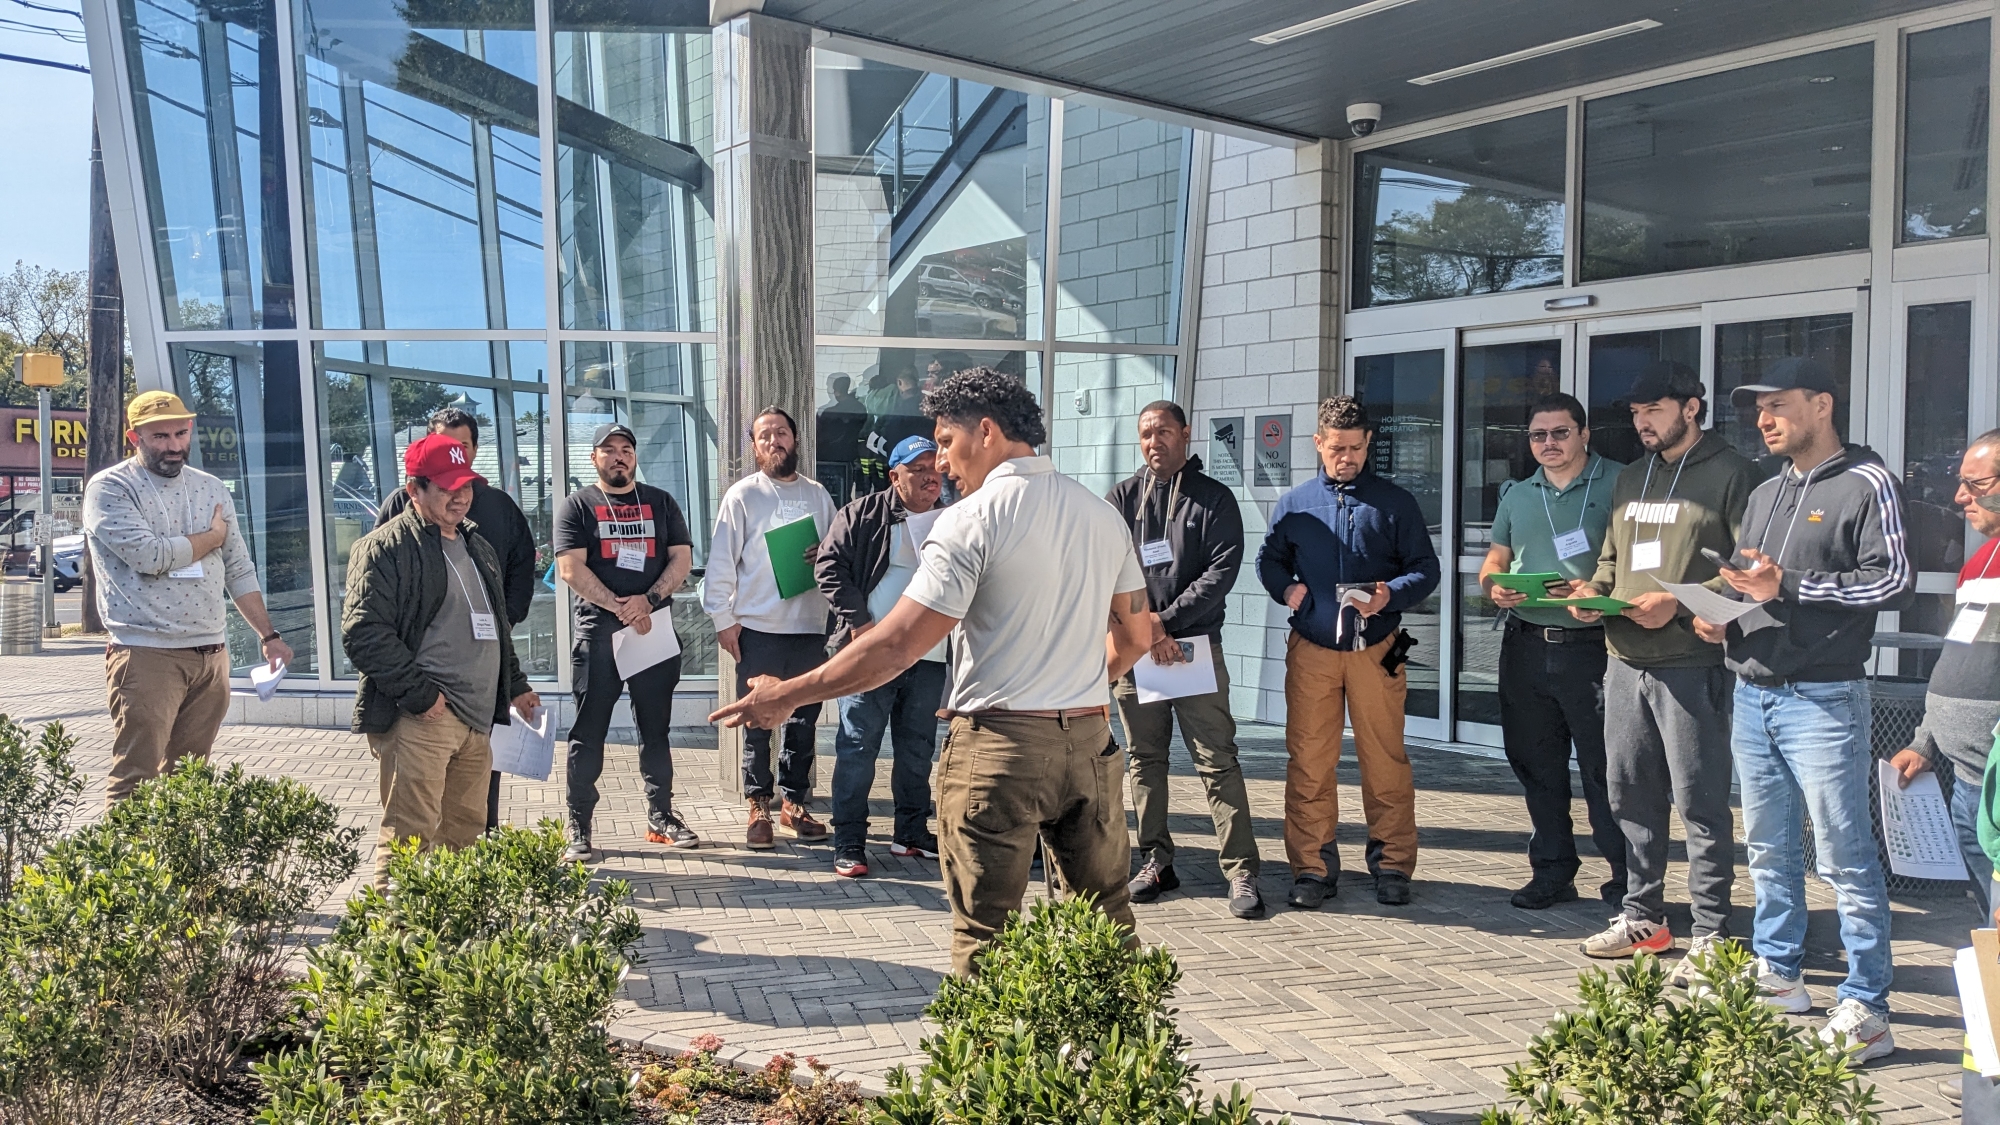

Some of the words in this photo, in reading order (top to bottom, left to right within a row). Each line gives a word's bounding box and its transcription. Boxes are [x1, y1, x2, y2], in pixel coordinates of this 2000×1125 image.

[1381, 416, 1405, 424] HOURS
[16, 418, 87, 445] FURN
[1379, 425, 1420, 433] OPERATION
[1265, 450, 1279, 460] NO
[1257, 461, 1287, 470] SMOKING
[1623, 501, 1680, 524] PUMA
[608, 523, 646, 536] PUMA
